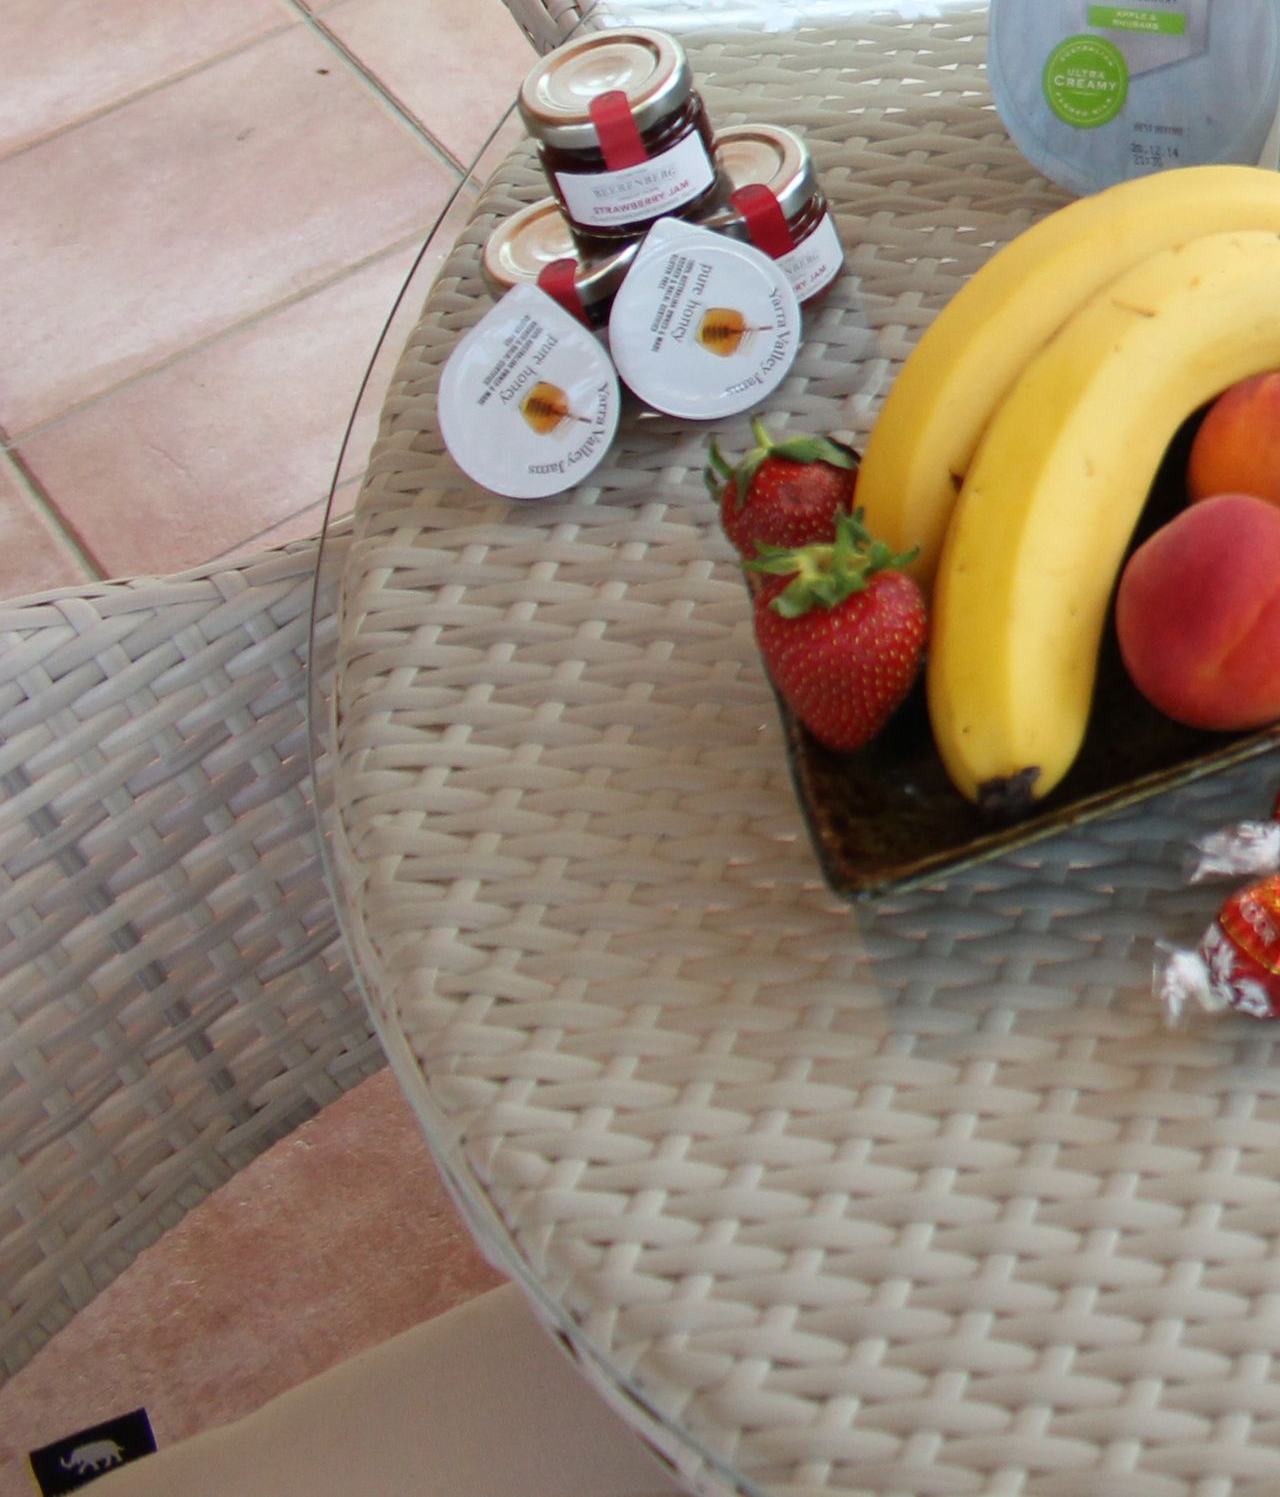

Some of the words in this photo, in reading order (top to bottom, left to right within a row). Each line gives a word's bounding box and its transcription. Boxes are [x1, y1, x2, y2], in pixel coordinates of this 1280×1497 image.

[1054, 74, 1118, 92] CREAMY
[592, 191, 665, 216] STRAWBERRY
[669, 179, 690, 196] JAM
[692, 263, 713, 296] pure
[671, 299, 703, 343] honey
[768, 287, 787, 329] Yarra
[533, 333, 559, 366] pure
[760, 331, 791, 376] Valley
[500, 365, 539, 405] honey
[597, 382, 609, 426] Yarra
[567, 429, 606, 467] Valley
[528, 460, 566, 476] Jams
